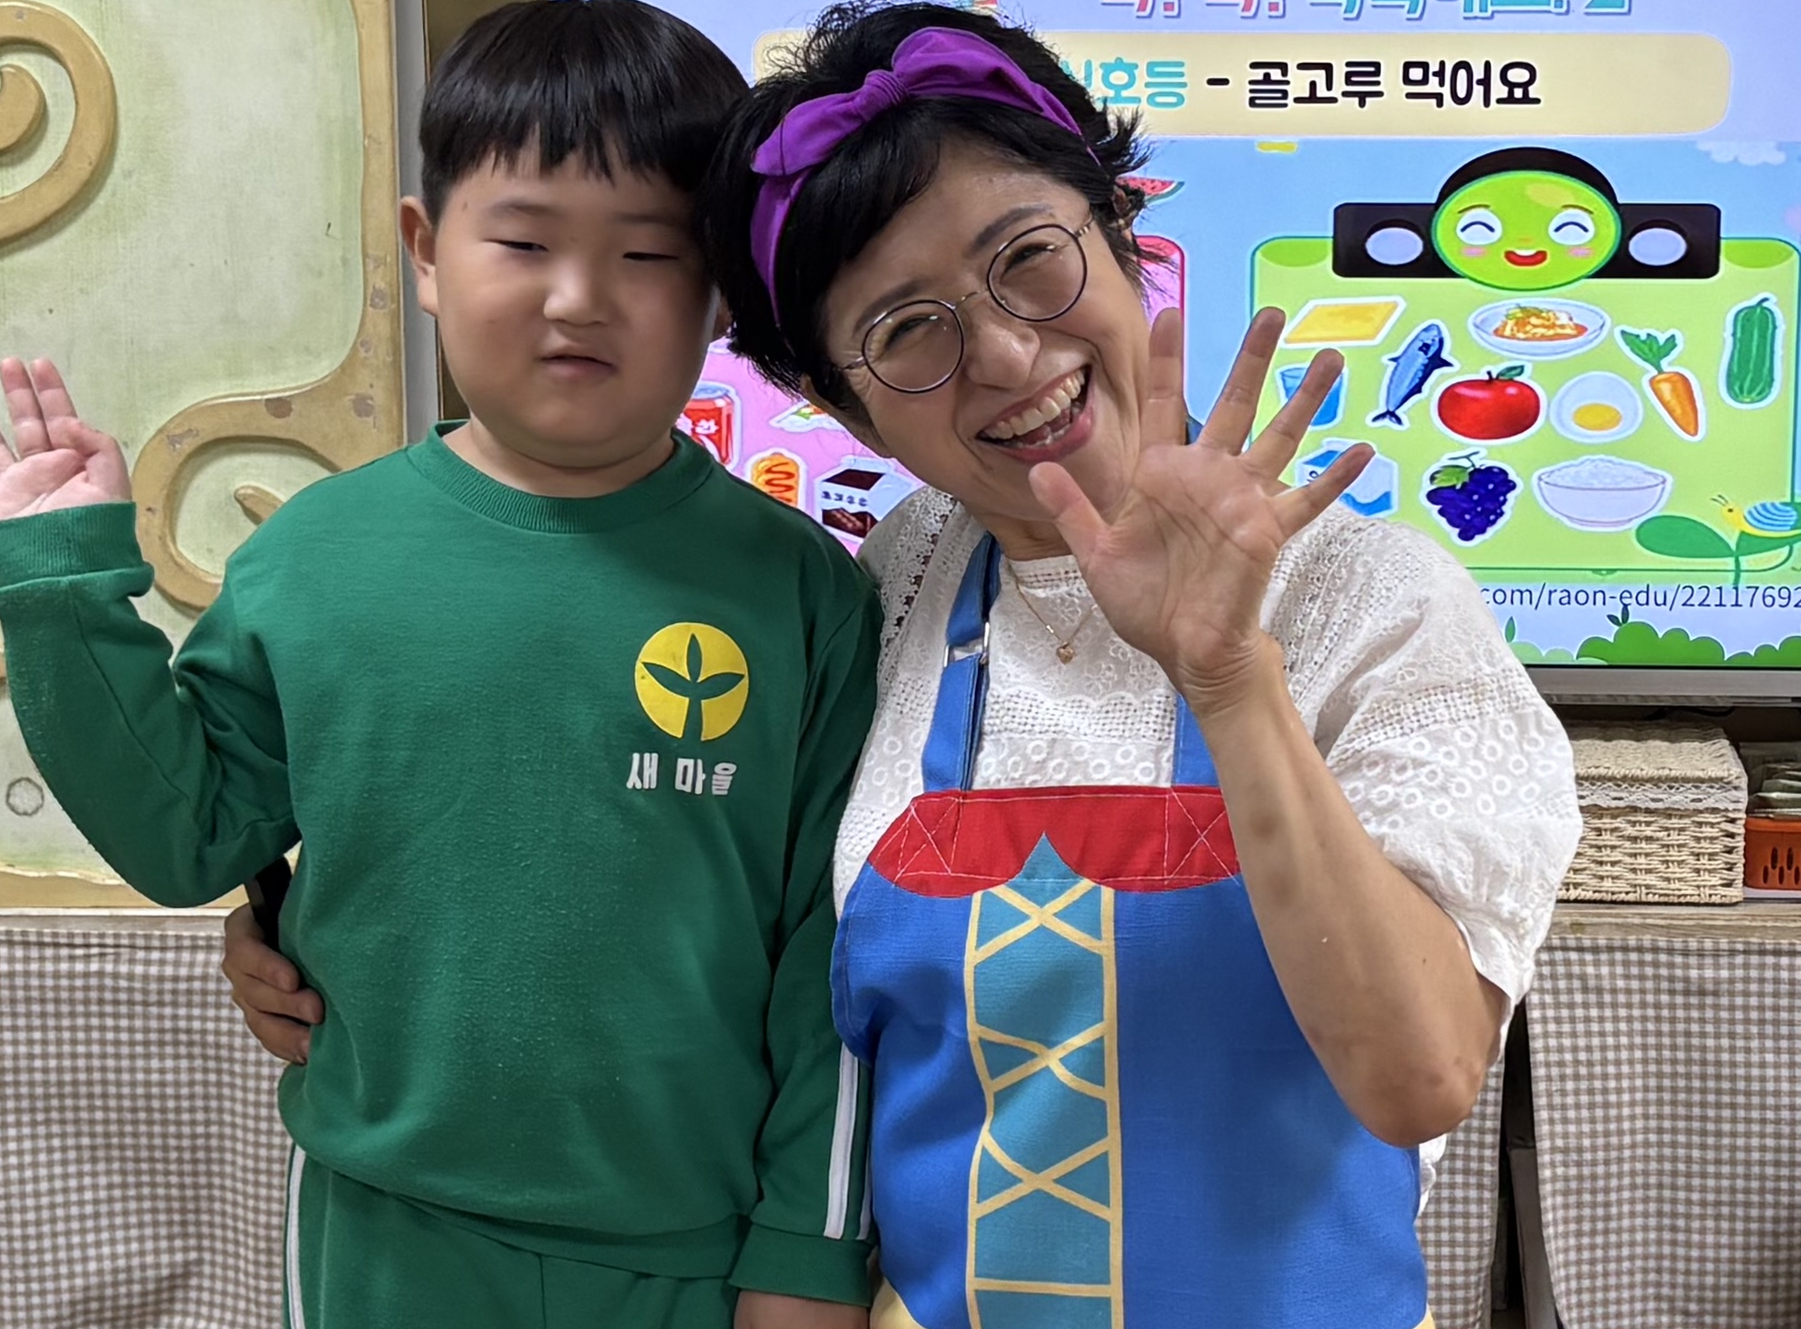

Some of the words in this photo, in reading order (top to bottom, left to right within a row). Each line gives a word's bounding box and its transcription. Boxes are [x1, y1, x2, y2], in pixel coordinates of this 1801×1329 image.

[1064, 57, 1188, 109] 호등
[1247, 60, 1385, 109] 골고루
[1402, 59, 1542, 109] 먹어요
